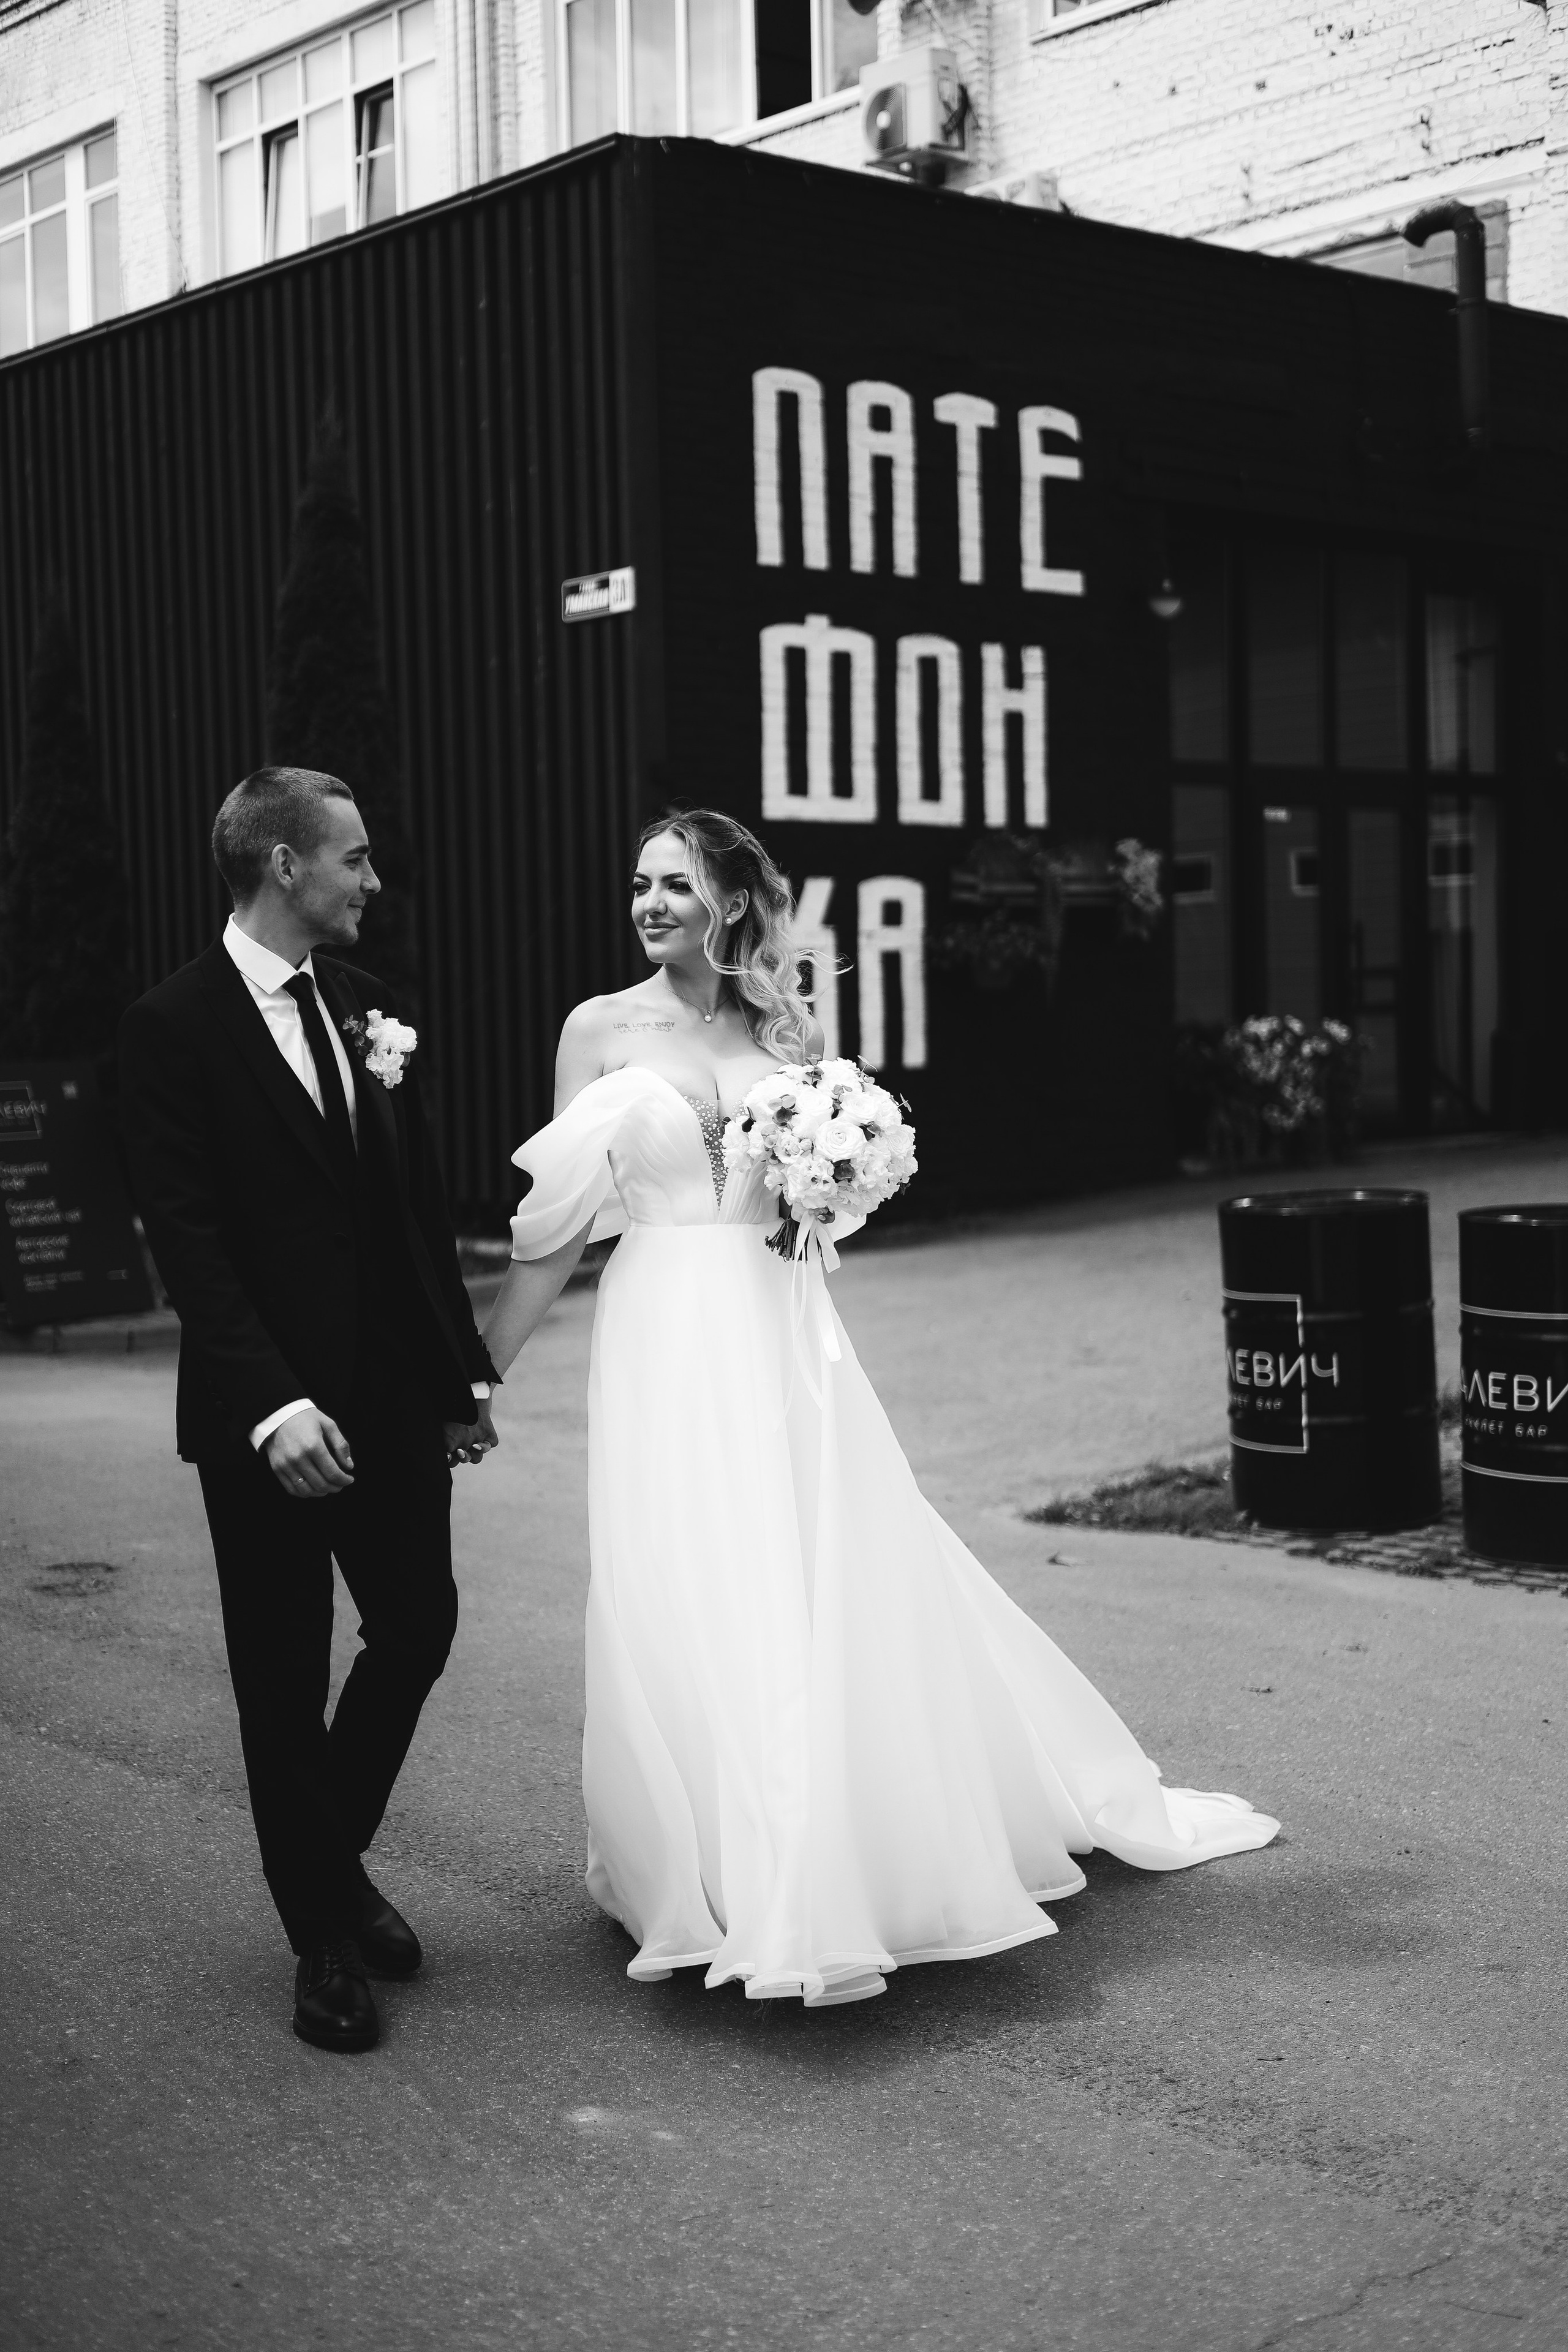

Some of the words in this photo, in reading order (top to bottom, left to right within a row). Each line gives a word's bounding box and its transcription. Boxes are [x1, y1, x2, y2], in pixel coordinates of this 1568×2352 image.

[752, 366, 1085, 597] ПАТЕ
[759, 613, 1049, 829] ФОН
[1514, 1422, 1548, 1438] БАР
